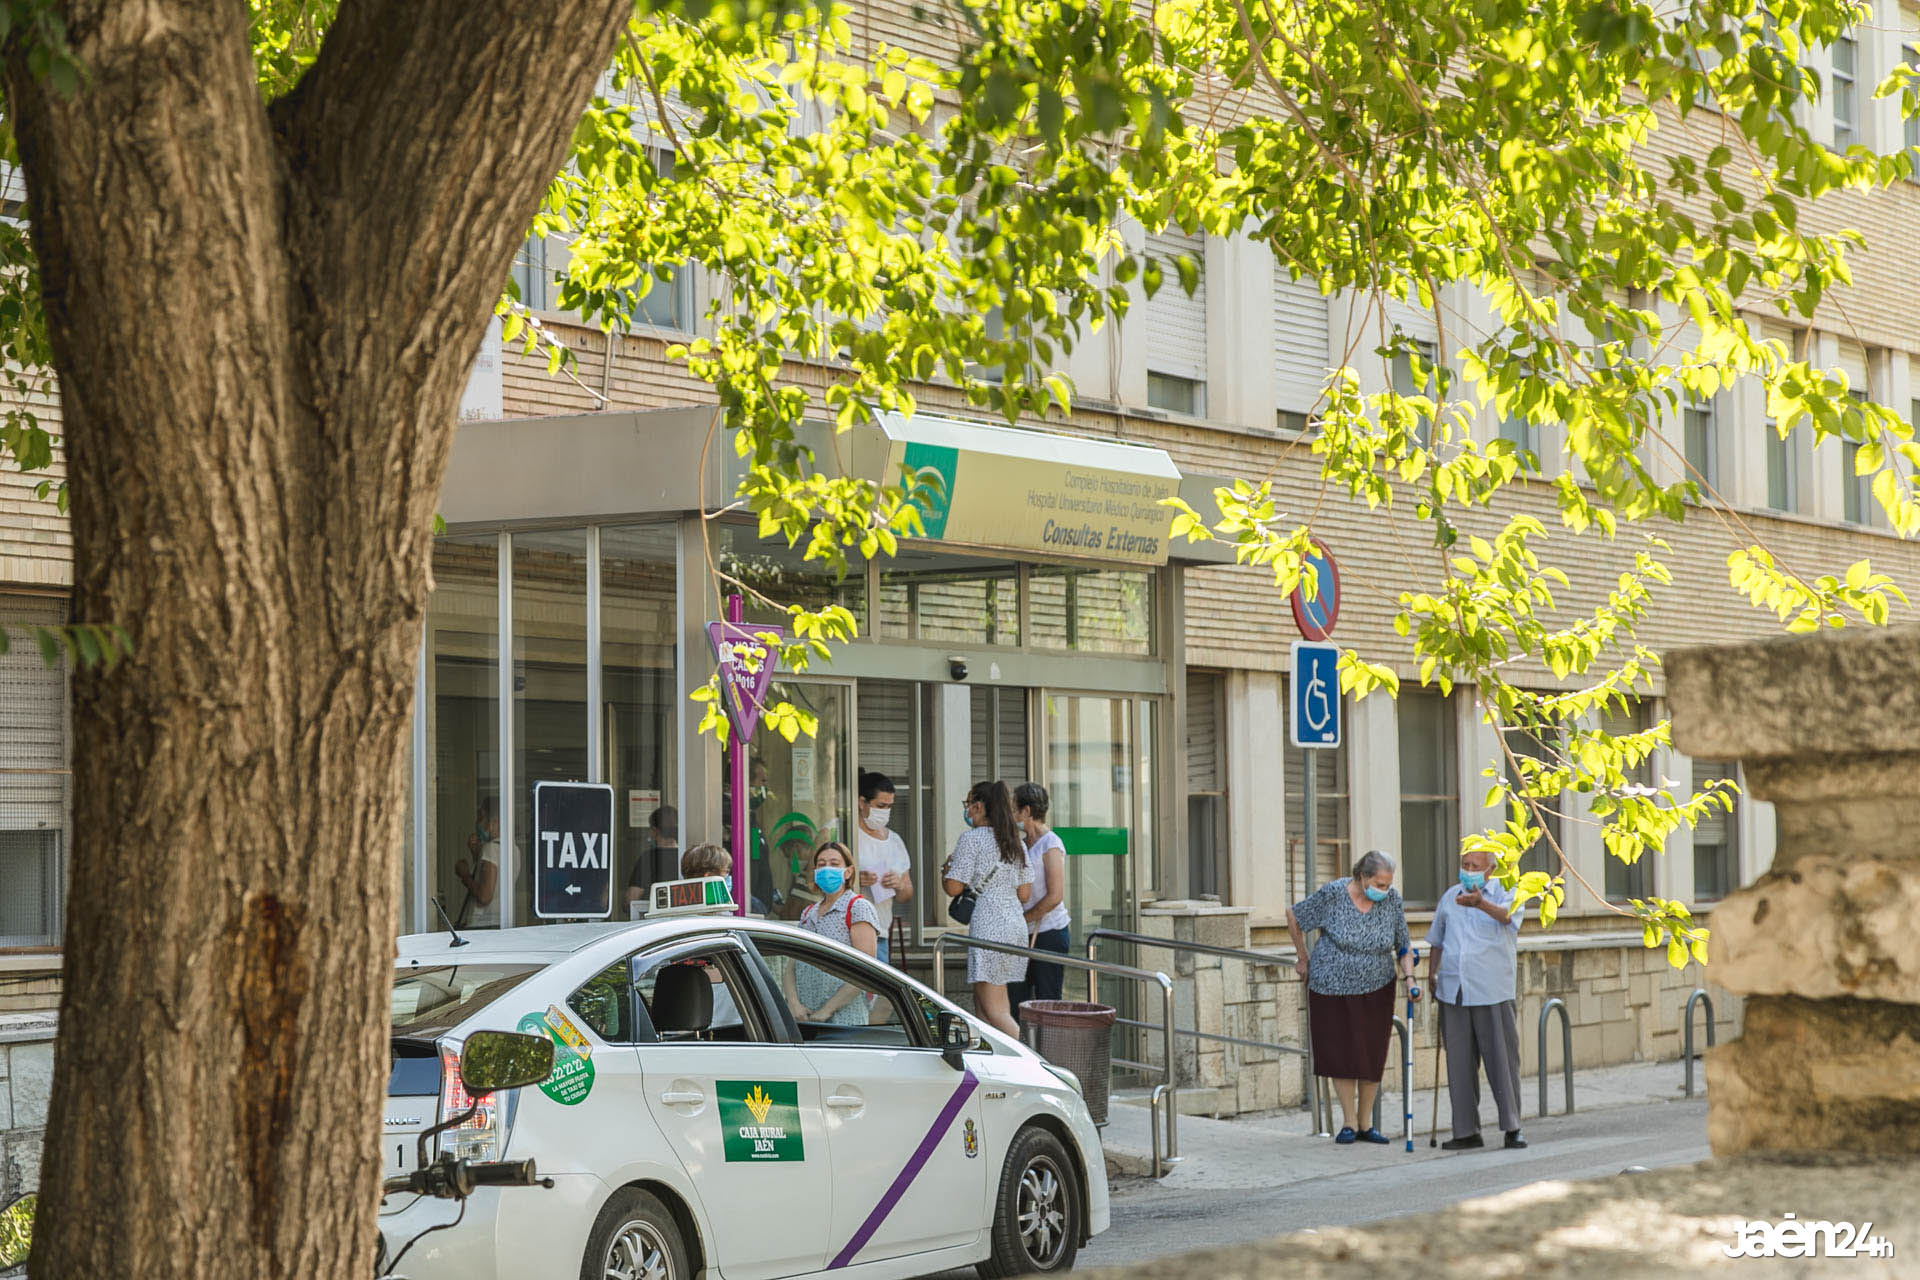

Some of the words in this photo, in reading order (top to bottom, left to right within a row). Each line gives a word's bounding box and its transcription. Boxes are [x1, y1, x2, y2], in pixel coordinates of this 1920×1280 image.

[1064, 470, 1098, 494] Complejo
[1100, 475, 1141, 498] Hospitalario
[1142, 481, 1151, 497] de
[1027, 489, 1057, 511] Hospital
[1058, 492, 1103, 514] Universitario
[1043, 518, 1103, 549] Consultas
[1106, 526, 1159, 554] Externas
[741, 676, 755, 689] 016
[541, 831, 608, 869] TAXI
[671, 883, 703, 906] TAXI
[558, 1078, 575, 1089] MAYOR
[567, 1085, 578, 1093] TAXI
[739, 1126, 759, 1139] CAJA
[759, 1126, 787, 1139] RURAL
[754, 1137, 774, 1152] JAÉN
